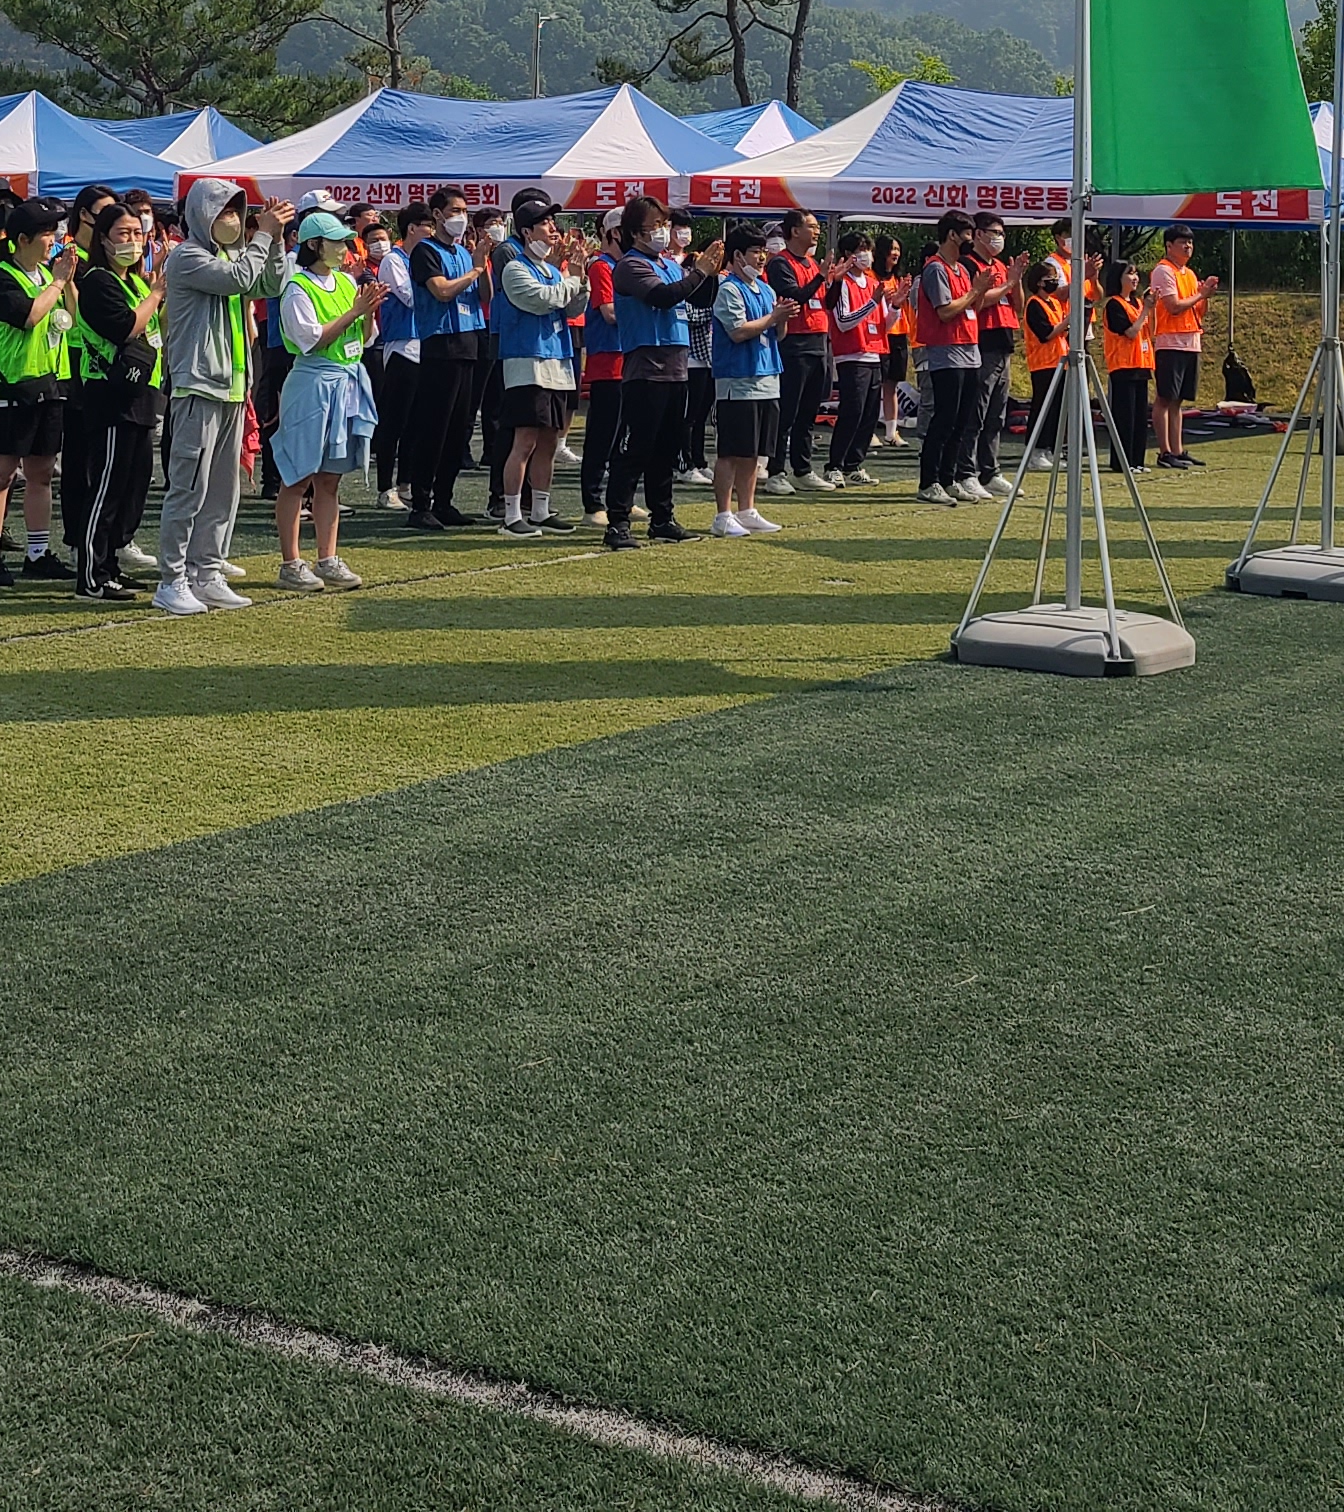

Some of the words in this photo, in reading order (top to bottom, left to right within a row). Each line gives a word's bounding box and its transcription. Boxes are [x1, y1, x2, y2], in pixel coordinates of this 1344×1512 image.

[366, 183, 402, 205] 신화
[709, 178, 761, 204] 도전
[871, 186, 917, 204] 2022
[923, 184, 969, 208] 신화
[977, 185, 1072, 211] 명랑운동
[1216, 189, 1279, 217] 도전
